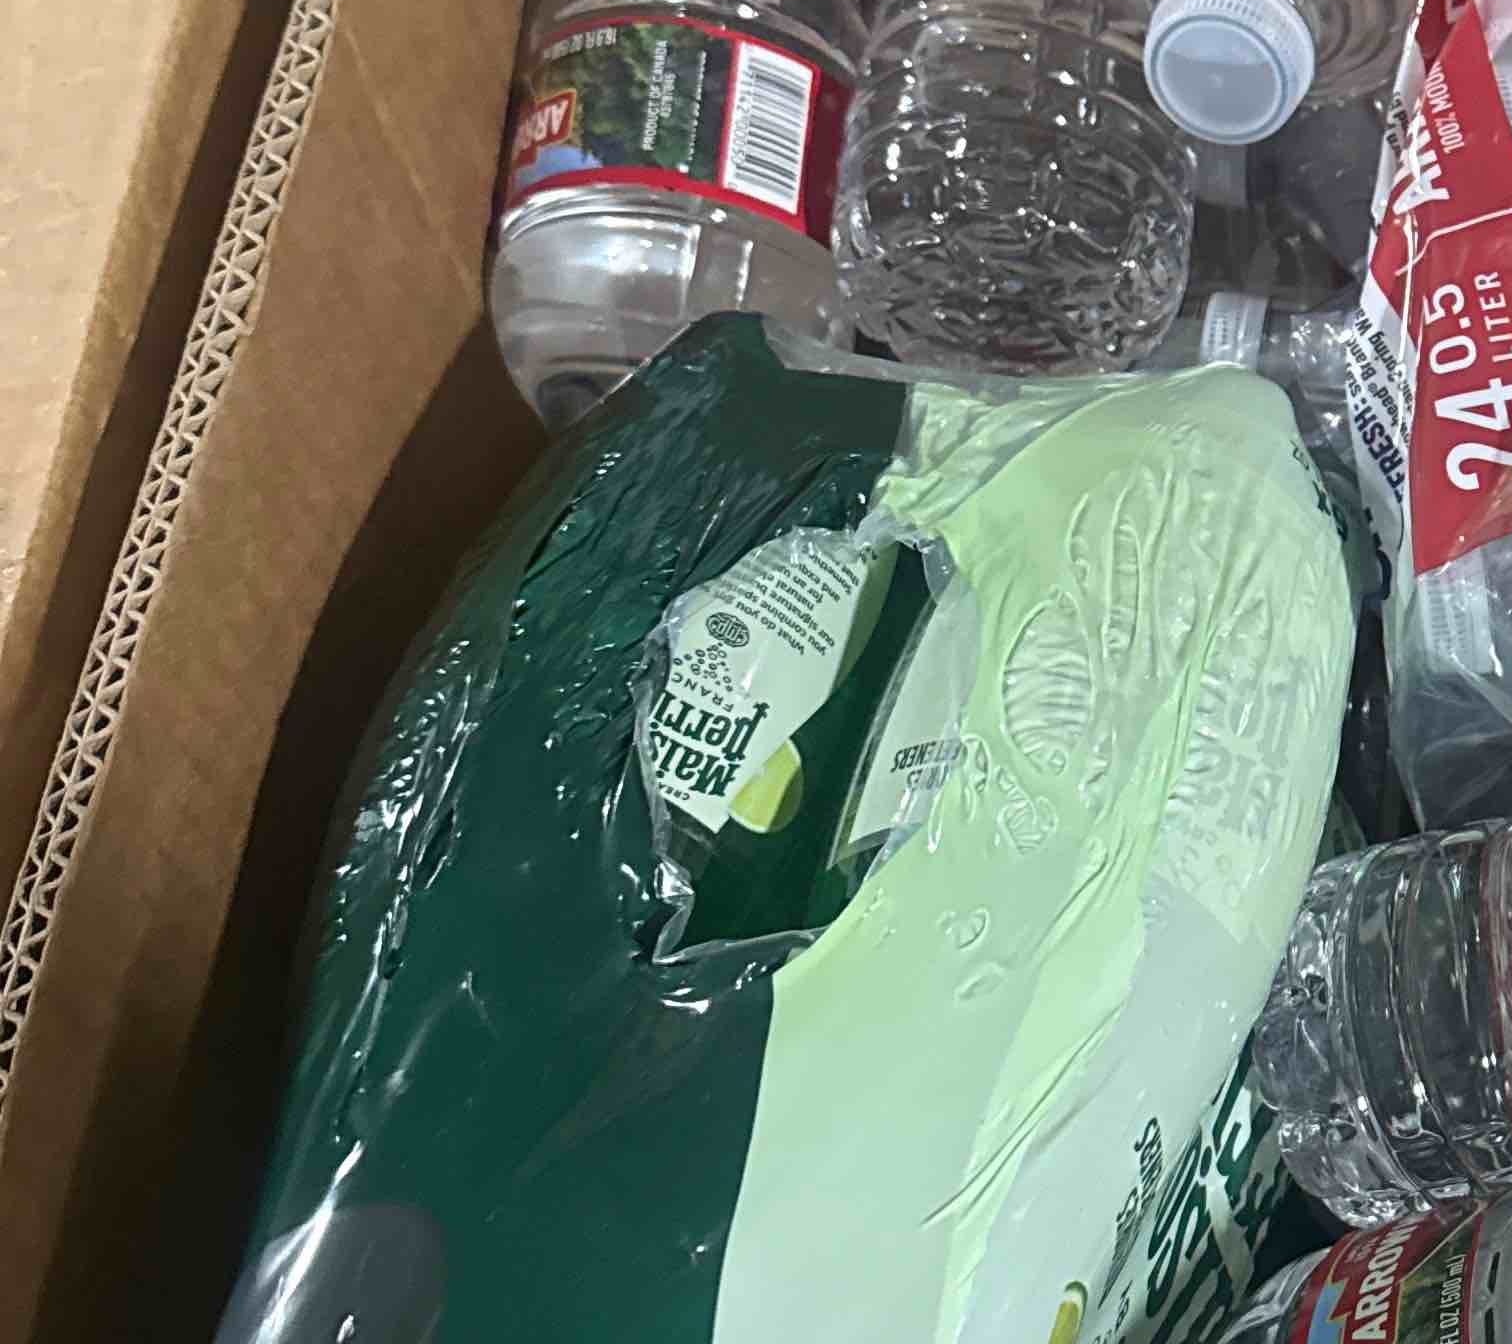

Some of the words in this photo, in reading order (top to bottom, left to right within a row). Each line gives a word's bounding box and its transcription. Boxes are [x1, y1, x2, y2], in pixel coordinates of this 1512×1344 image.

[642, 99, 661, 152] PRODUCT
[1423, 283, 1478, 375] 0.5
[735, 600, 761, 620] you
[769, 591, 820, 630] signature
[776, 579, 815, 612] natural
[759, 599, 807, 637] combine
[760, 615, 777, 631] do
[777, 627, 805, 655] What
[807, 639, 829, 656] you
[1439, 1277, 1464, 1308] (500
[1439, 1308, 1460, 1329] OZ
